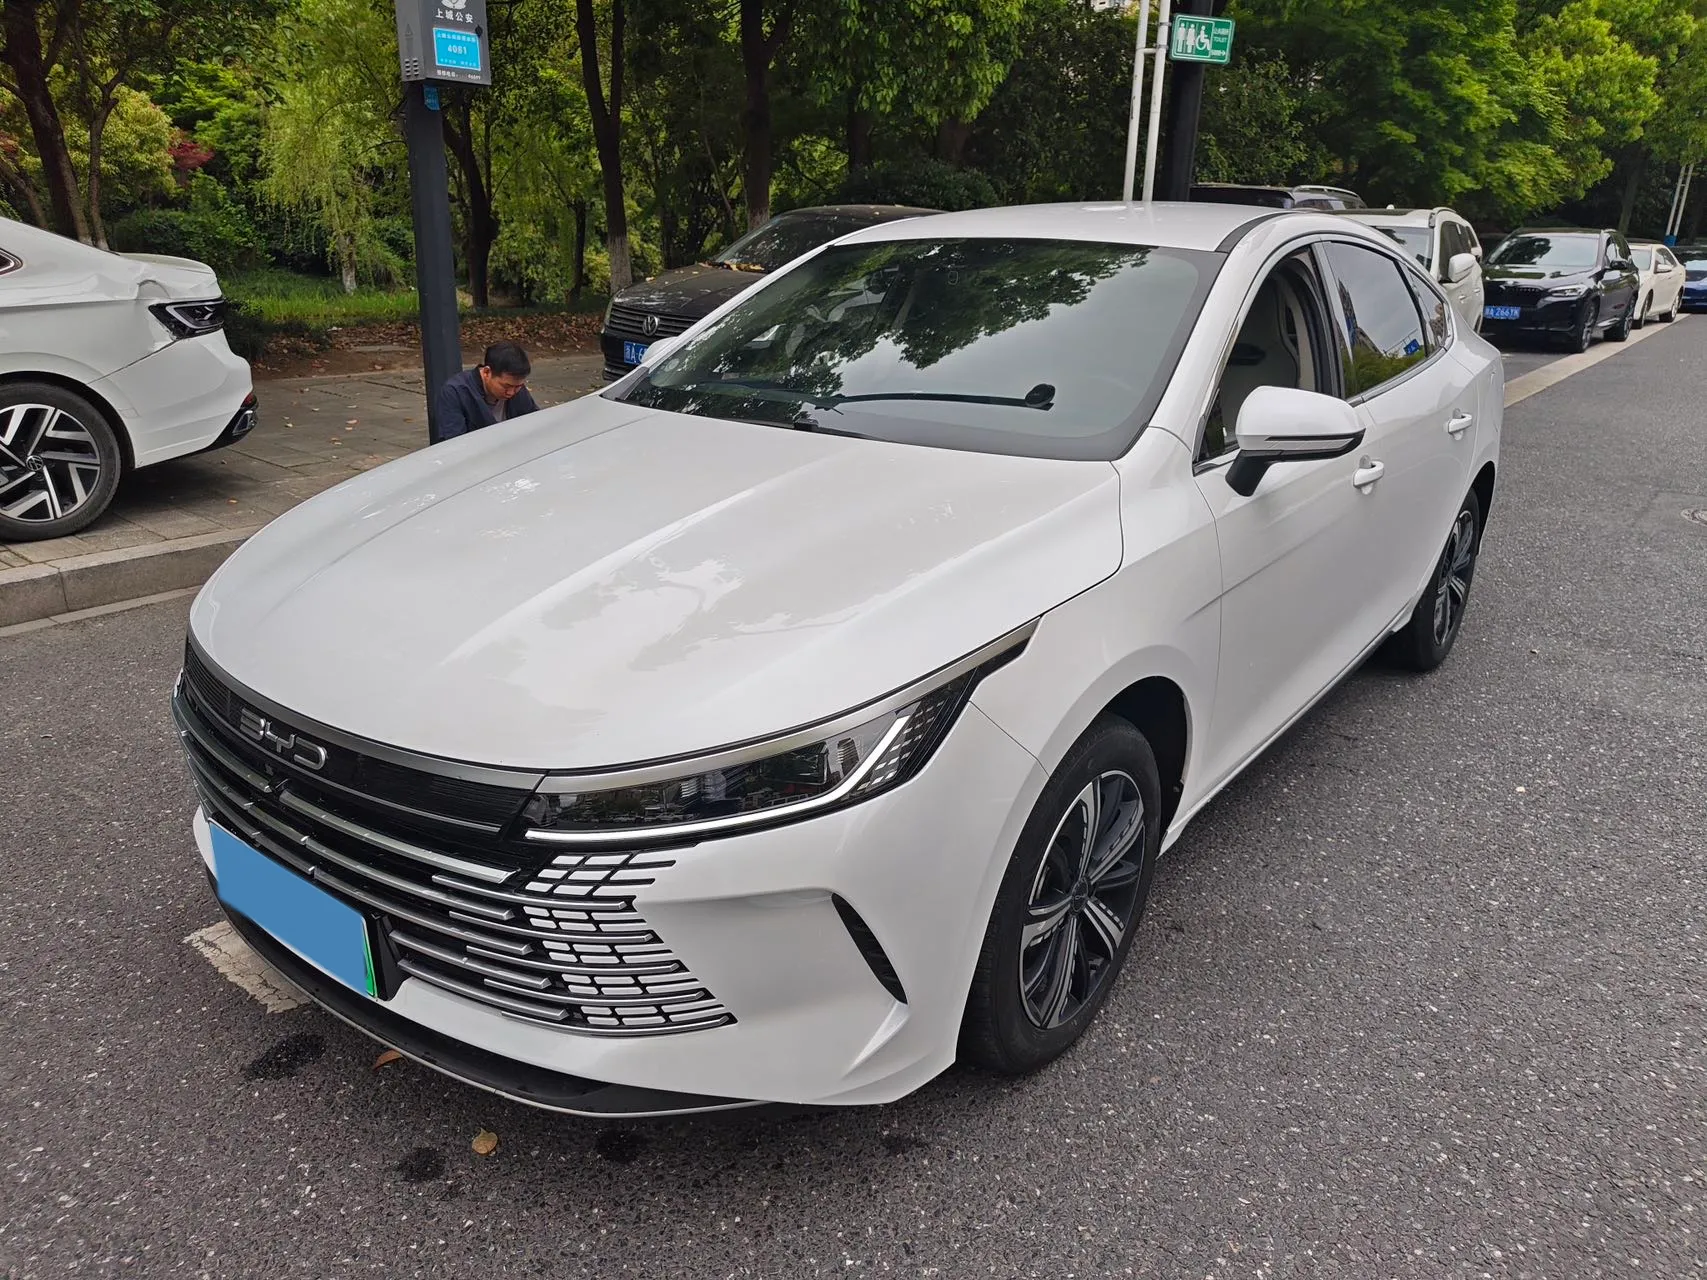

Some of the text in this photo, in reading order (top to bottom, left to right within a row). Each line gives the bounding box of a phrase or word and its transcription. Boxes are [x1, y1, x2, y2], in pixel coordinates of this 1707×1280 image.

[435, 8, 474, 23] 上城公安
[240, 707, 327, 770] BYD
